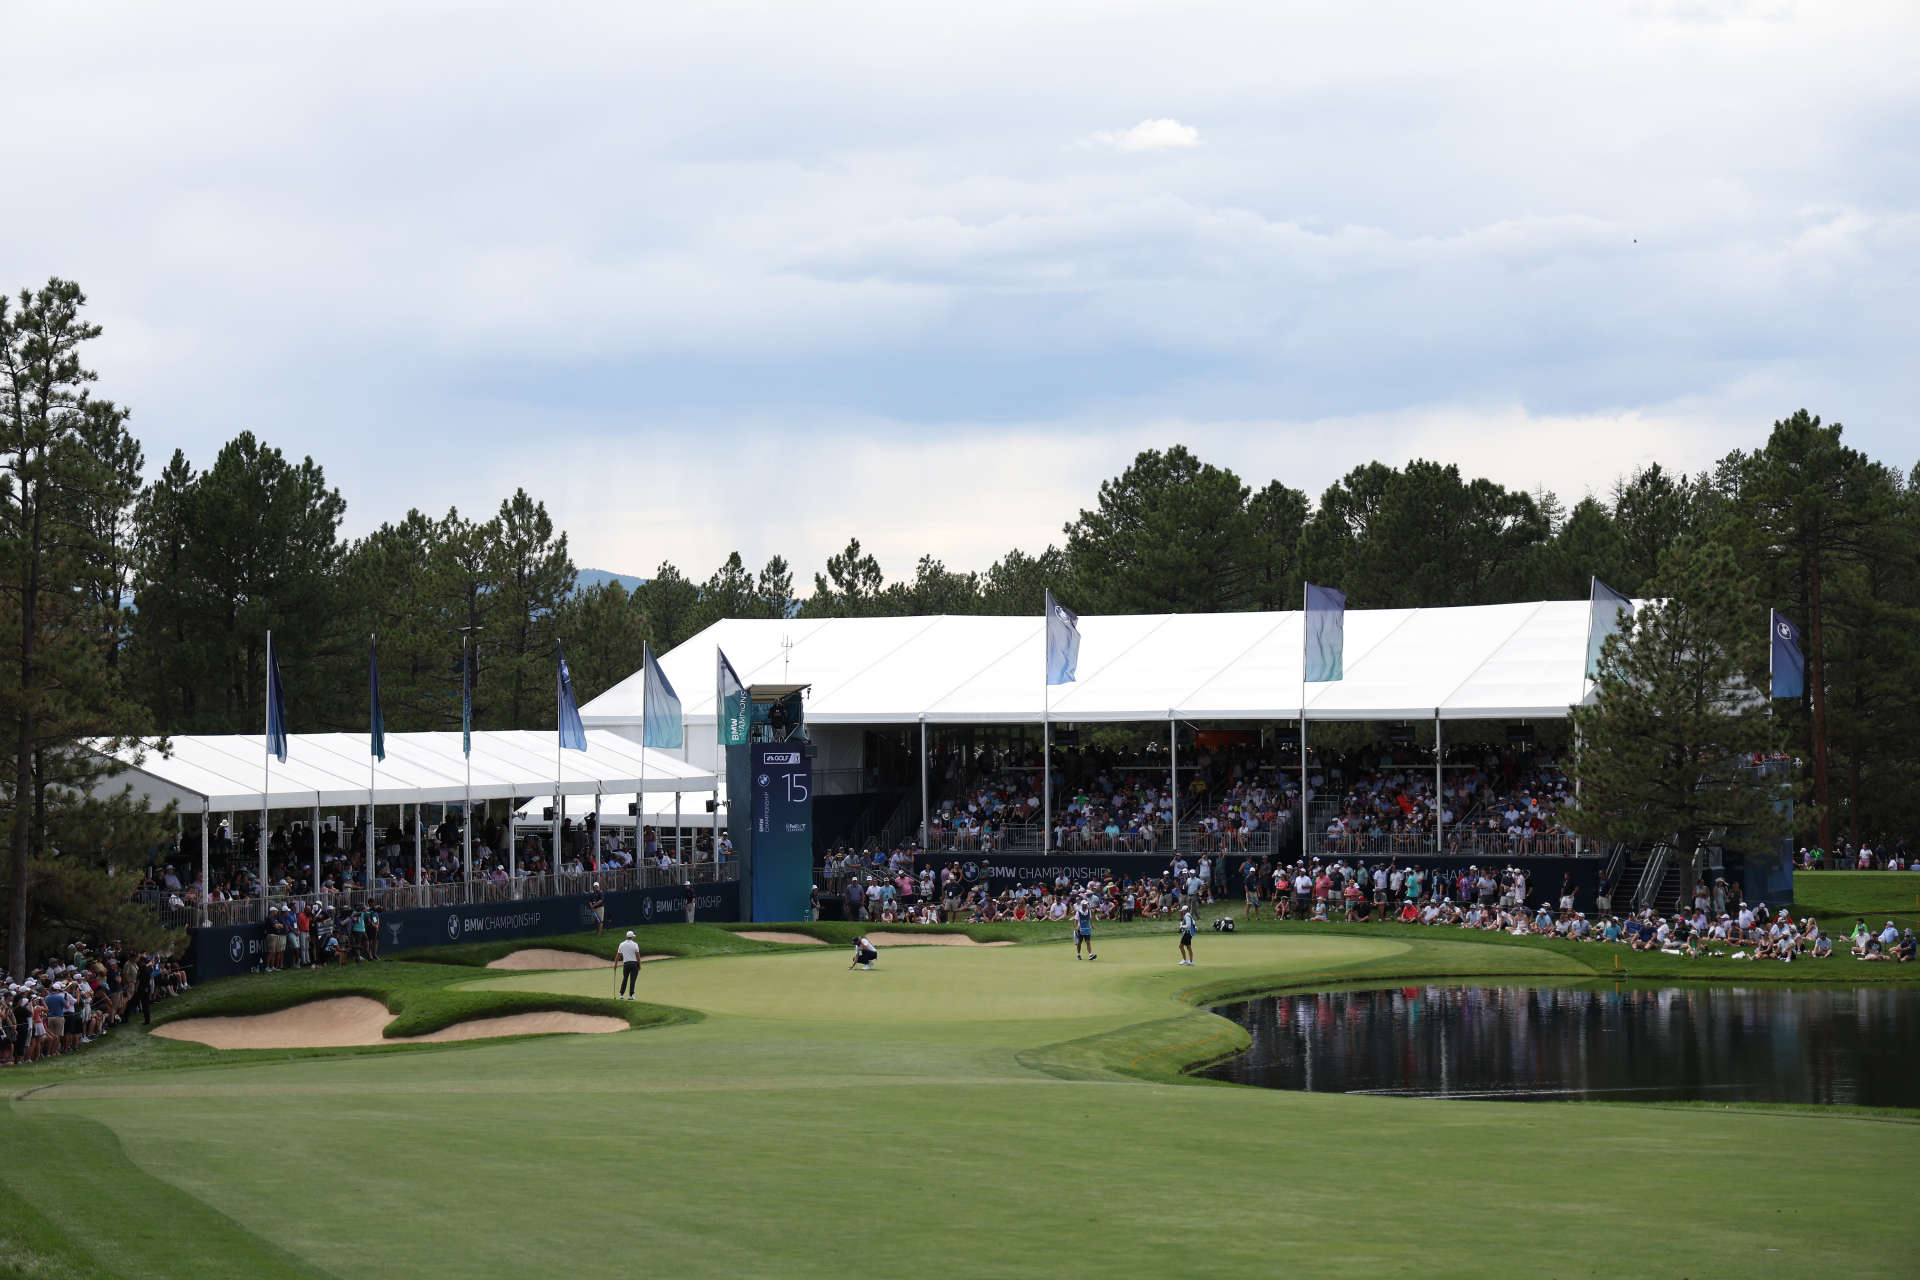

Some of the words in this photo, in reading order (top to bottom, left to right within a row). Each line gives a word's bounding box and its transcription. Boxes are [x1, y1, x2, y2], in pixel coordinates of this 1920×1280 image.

[730, 718, 739, 741] BMW
[781, 773, 808, 803] 15
[656, 899, 673, 913] BMW
[673, 895, 721, 912] CHAIONSHIP
[464, 918, 484, 932] BMW
[484, 912, 541, 930] CHAMPIONSHIP
